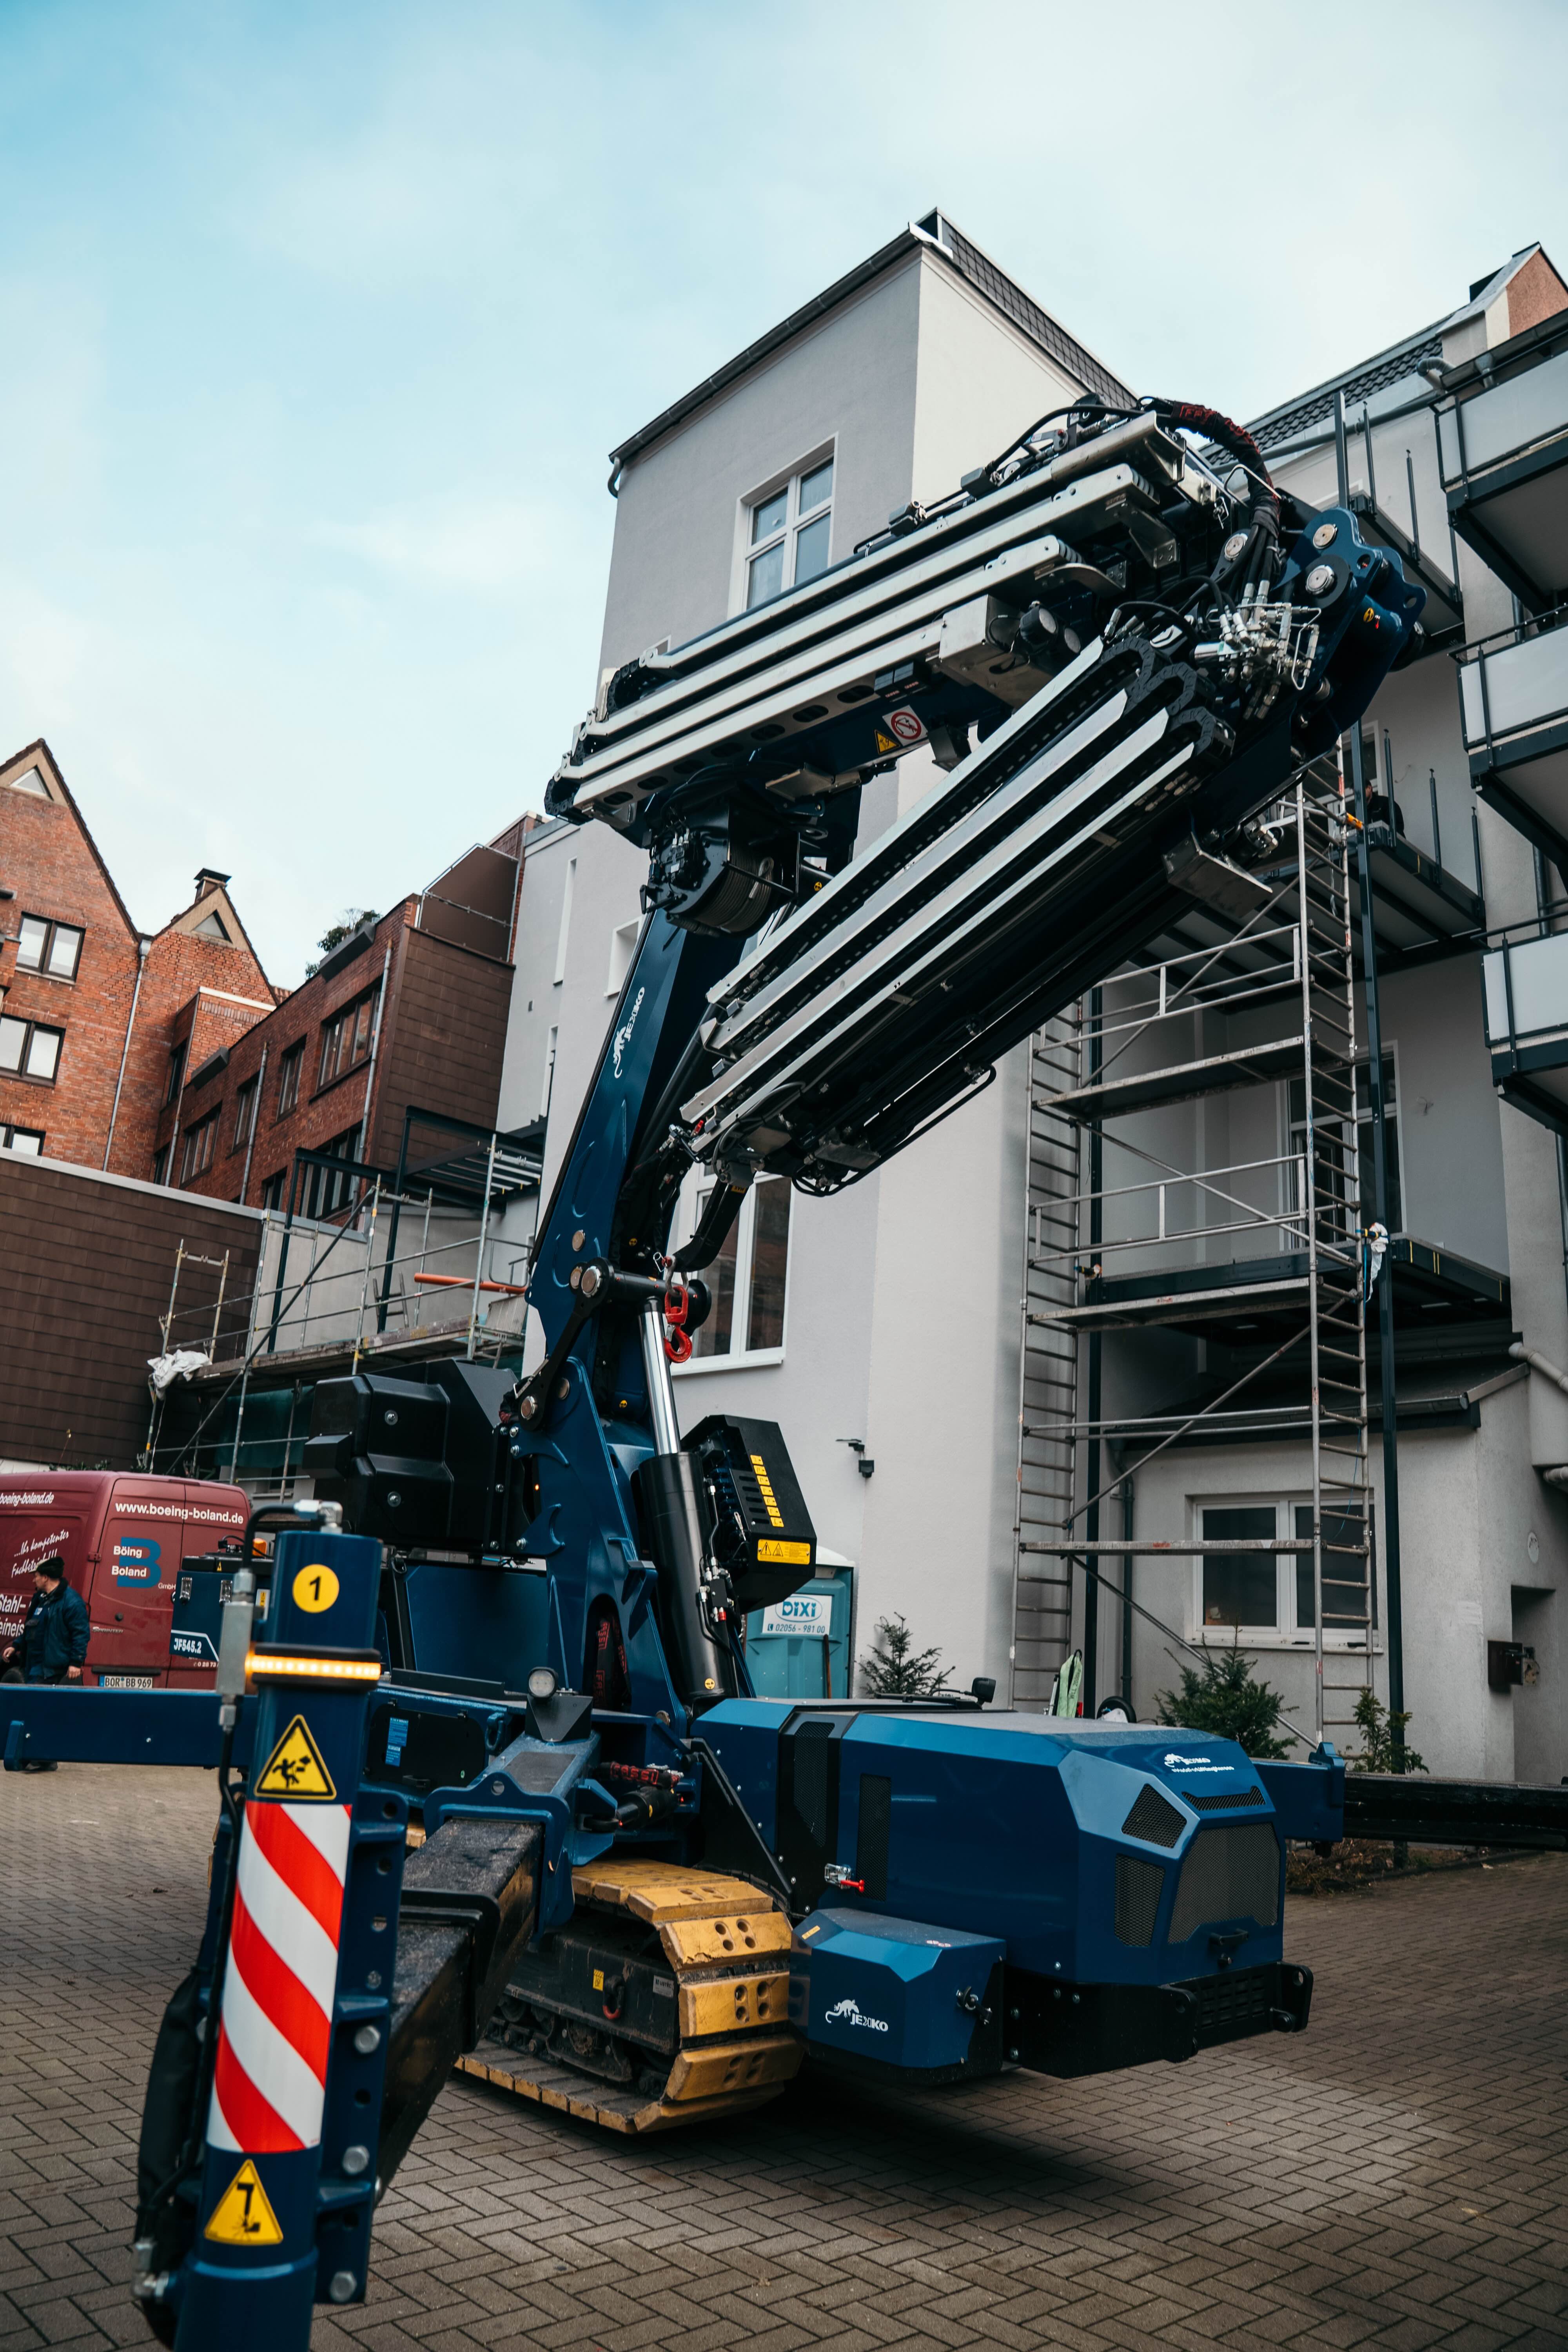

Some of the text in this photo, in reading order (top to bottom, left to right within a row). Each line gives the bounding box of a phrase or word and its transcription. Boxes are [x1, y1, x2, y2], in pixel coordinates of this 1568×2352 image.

[115, 1503, 244, 1524] www.boeing-boland.de
[31, 1529, 69, 1552] kompetenter
[113, 1546, 142, 1558] Böing
[111, 1565, 147, 1577] Boland
[310, 1575, 321, 1601] 1
[174, 1638, 202, 1654] JF545.2
[105, 1677, 151, 1688] BOR BB 969
